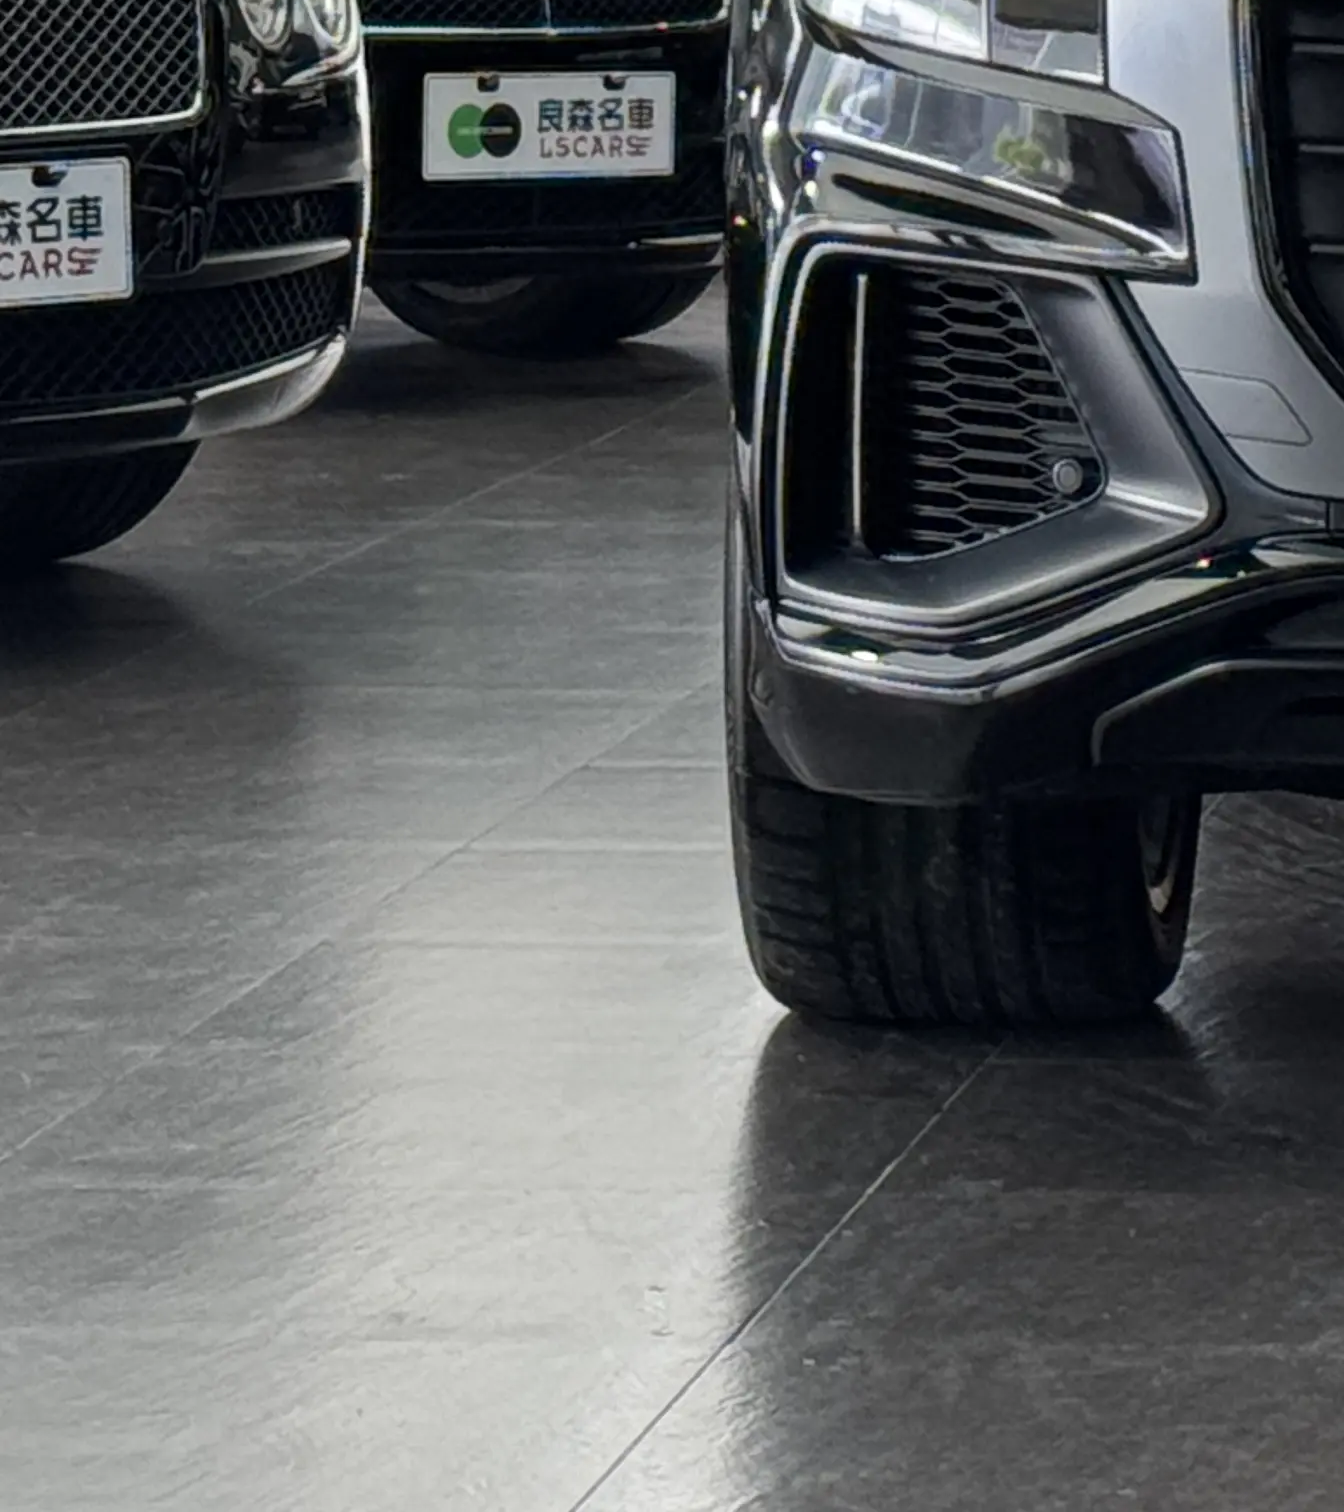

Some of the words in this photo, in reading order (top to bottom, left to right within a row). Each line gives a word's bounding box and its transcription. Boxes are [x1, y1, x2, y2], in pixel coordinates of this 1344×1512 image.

[537, 97, 654, 133] 良森名車
[539, 135, 652, 159] LSCARS
